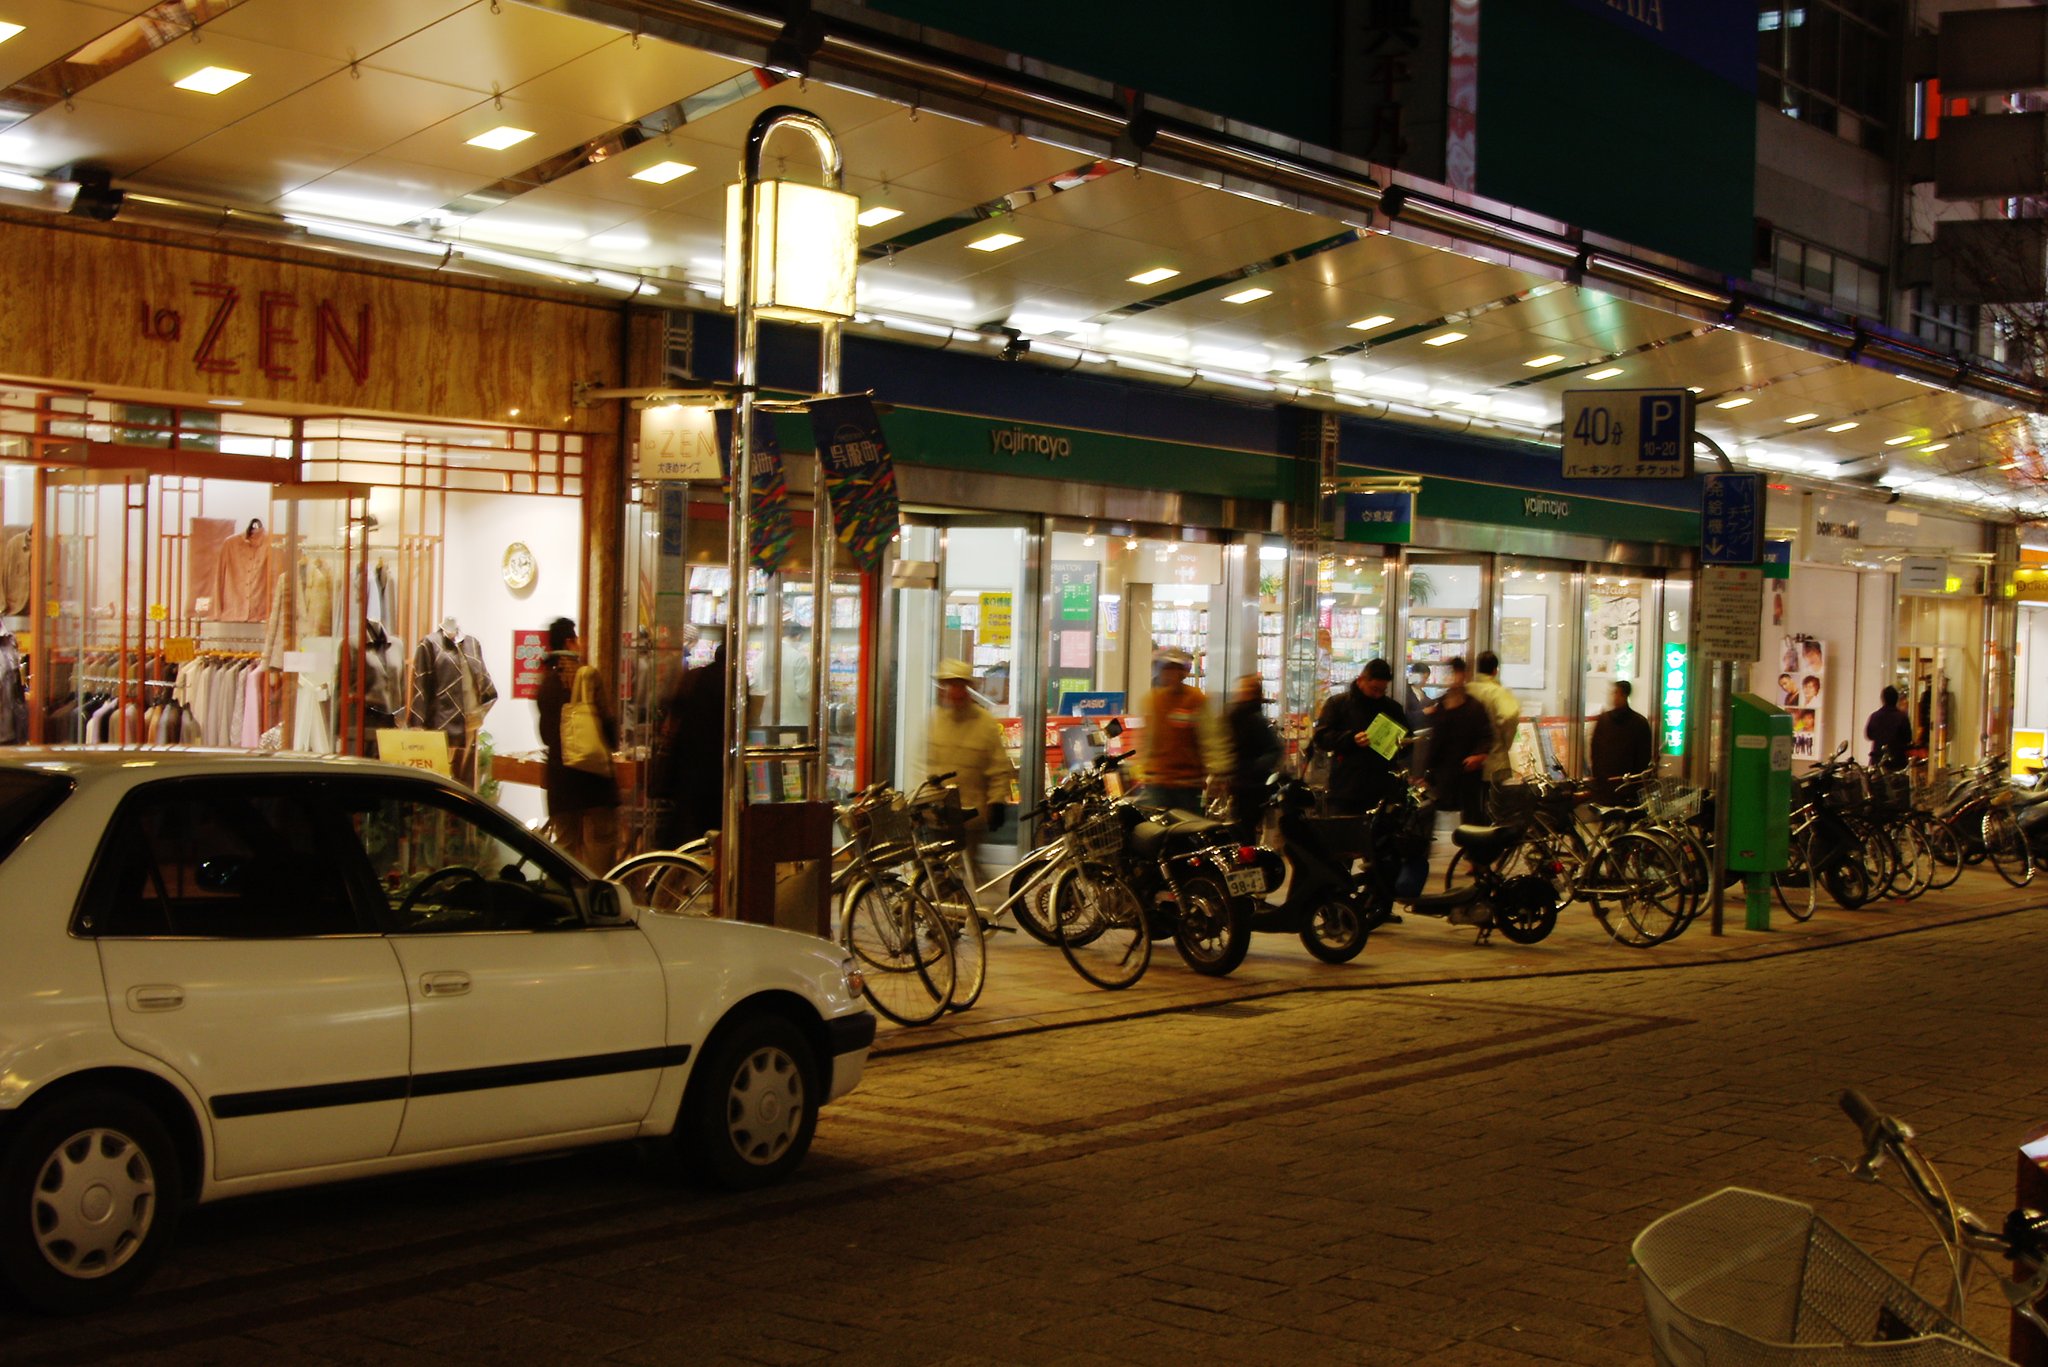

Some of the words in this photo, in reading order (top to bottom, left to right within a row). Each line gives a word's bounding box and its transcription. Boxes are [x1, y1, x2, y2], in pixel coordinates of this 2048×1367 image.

[190, 281, 371, 387] ZEN
[1573, 406, 1624, 446] 40分
[1651, 400, 1674, 437] P
[660, 430, 715, 459] ZEN
[991, 427, 1070, 461] yajimaya
[1643, 440, 1677, 457] 10-20
[1524, 495, 1569, 520] yajimaya
[408, 759, 433, 769] ZEN
